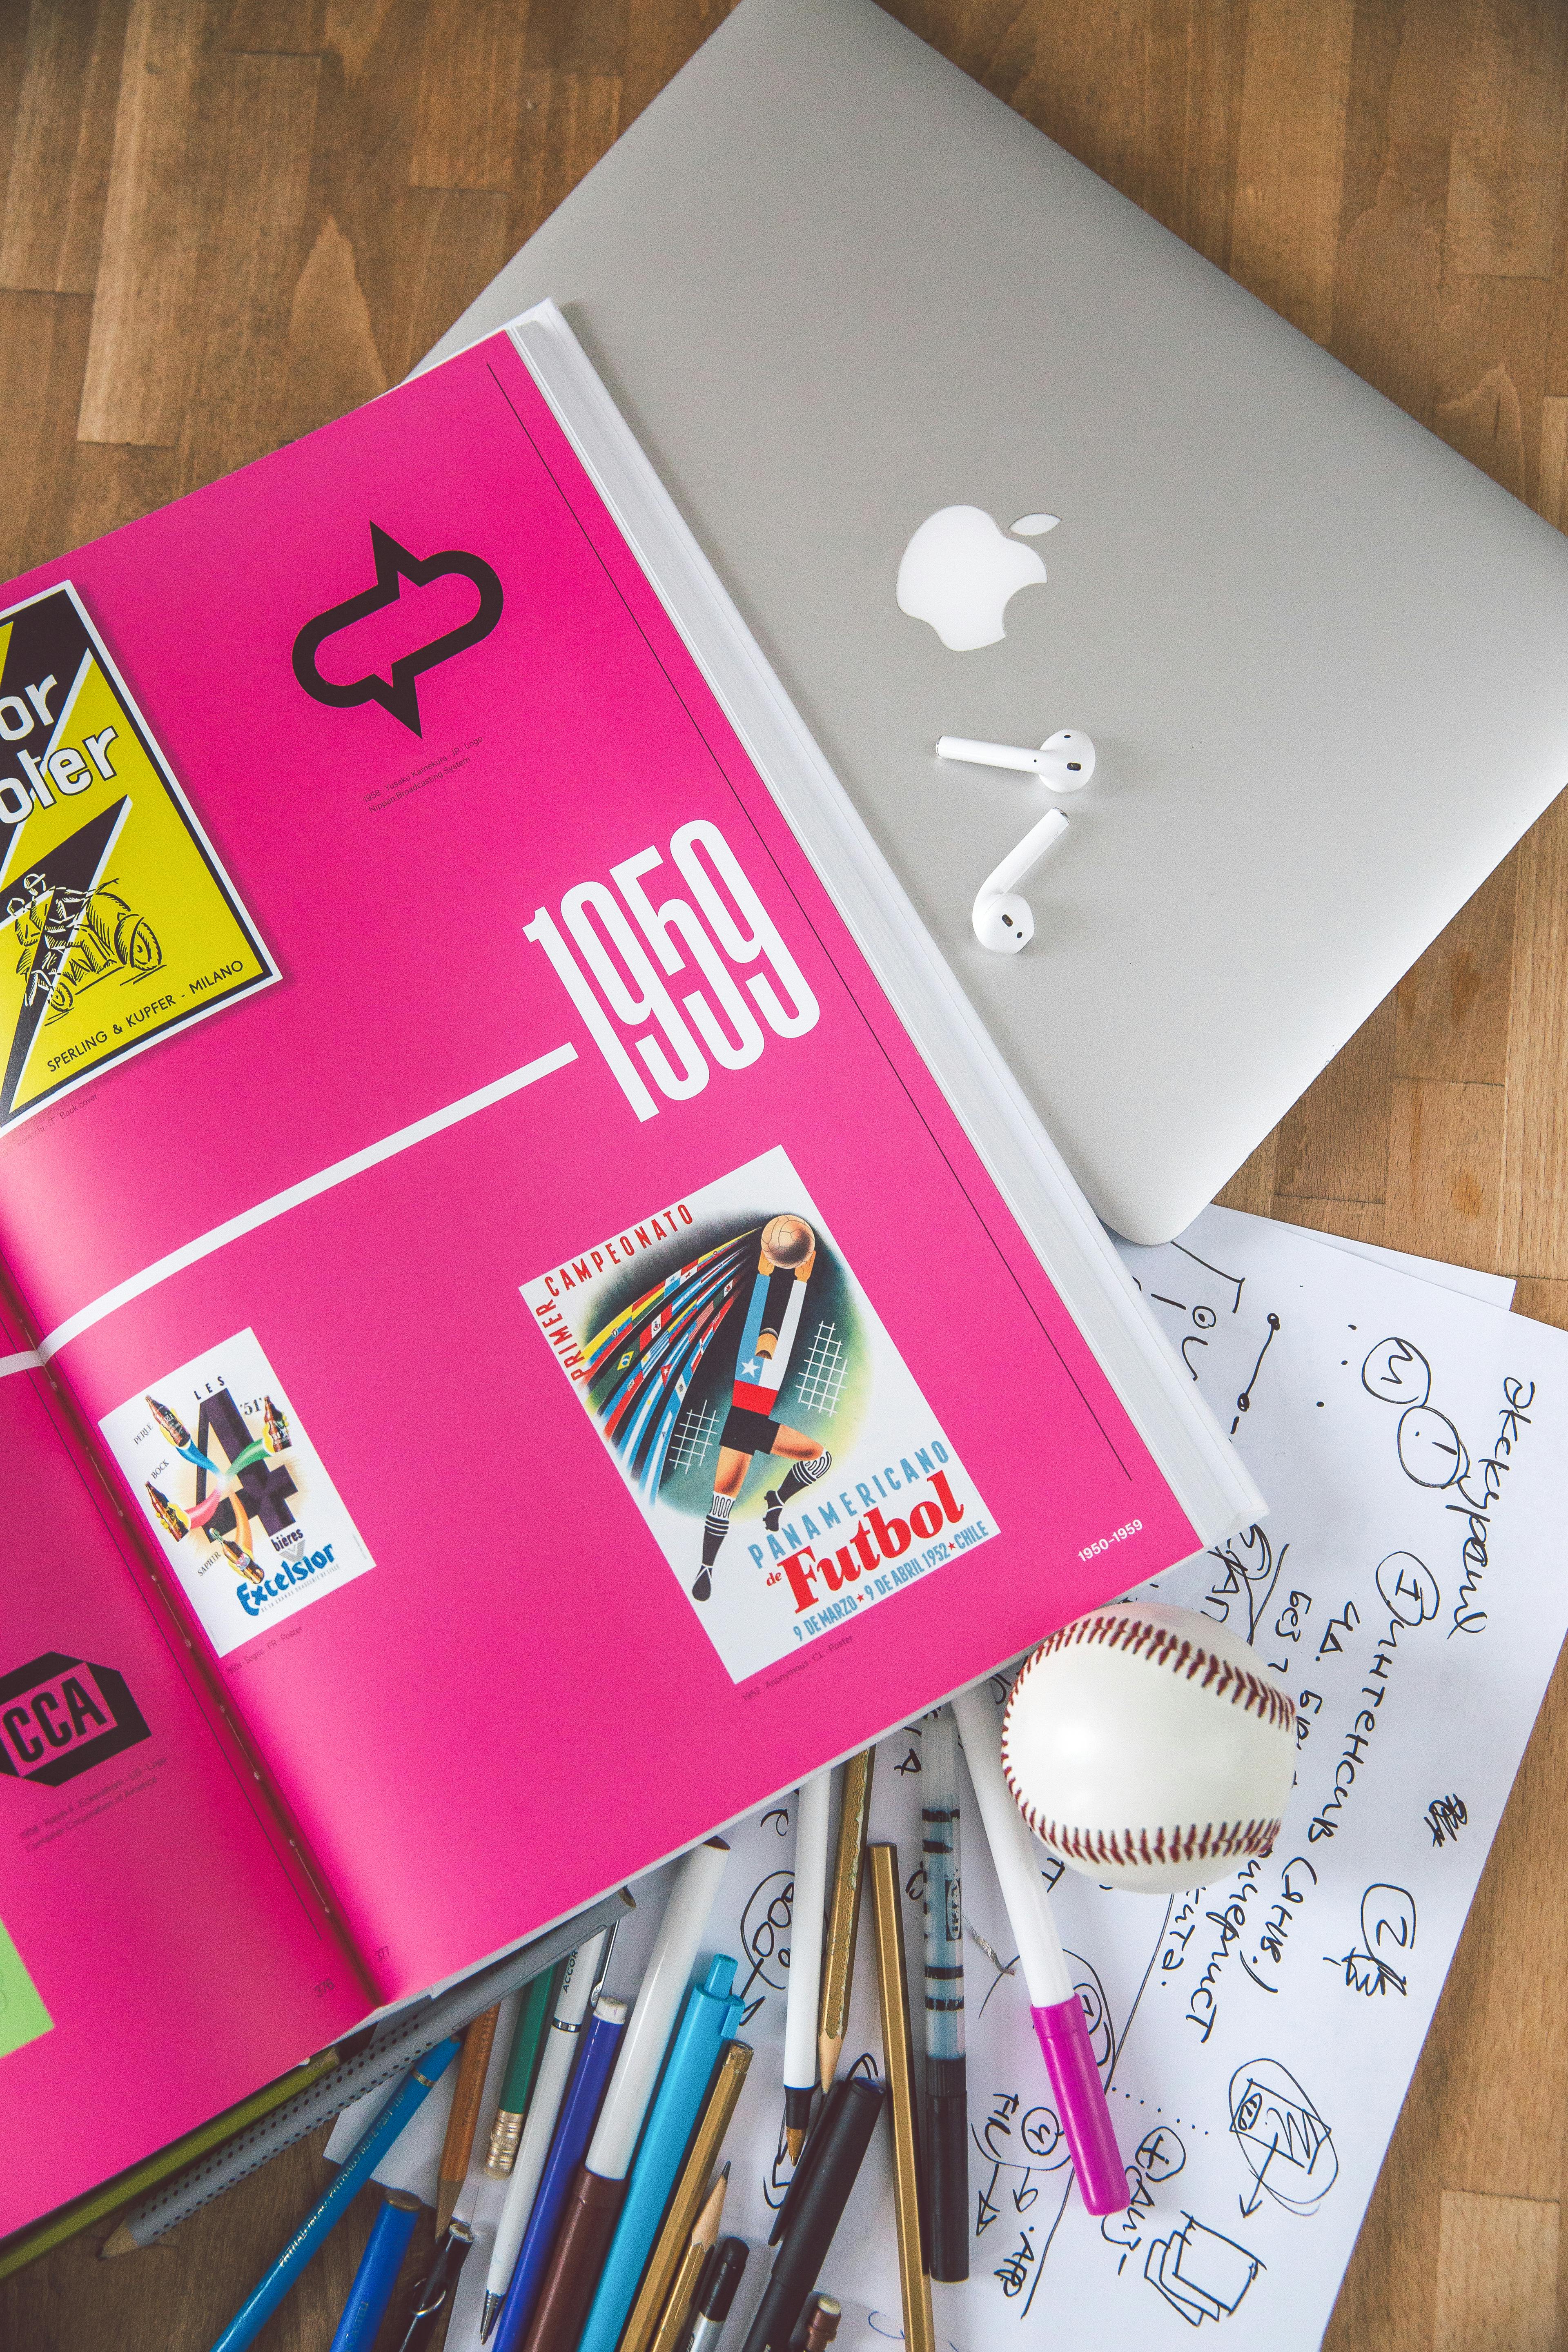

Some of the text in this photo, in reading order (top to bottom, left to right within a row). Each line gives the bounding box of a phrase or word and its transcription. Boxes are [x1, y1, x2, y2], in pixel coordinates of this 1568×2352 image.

[363, 735, 483, 802] 1958 Yusaku Kamekura JP Logo
[369, 756, 470, 813] Nippon Broadcasting System
[522, 820, 820, 1123] 1959
[48, 1031, 107, 1071] SPERLING
[113, 1025, 122, 1034] &
[126, 995, 175, 1027] KUPFER
[189, 961, 243, 993] MILANO
[60, 1105, 77, 1118] Book
[79, 1095, 97, 1107] cover
[536, 1205, 692, 1381] PRIMER CAMPEONATO
[194, 1377, 224, 1399] LES
[134, 1423, 154, 1445] PERLE
[151, 1459, 169, 1479] BOCK
[748, 1441, 949, 1568] PANAMERICANO
[272, 1530, 303, 1551] bières
[766, 1470, 964, 1613] de Futbol
[1078, 1519, 1143, 1561] 1950-1959
[197, 1552, 222, 1577] SAPHIR
[237, 1544, 334, 1615] Excelsior
[793, 1521, 988, 1641] 9 DE MARZO 9 DE ABRIL 1952 CHILE
[280, 1625, 302, 1641] Poster
[742, 1635, 853, 1701] 1952 Anonymous CL Poster
[2, 1677, 107, 1762] CCA
[375, 1946, 391, 1960] 377
[562, 1951, 578, 1993] ACCOR
[313, 1978, 335, 1998] 376
[359, 2130, 378, 2154] BLUE
